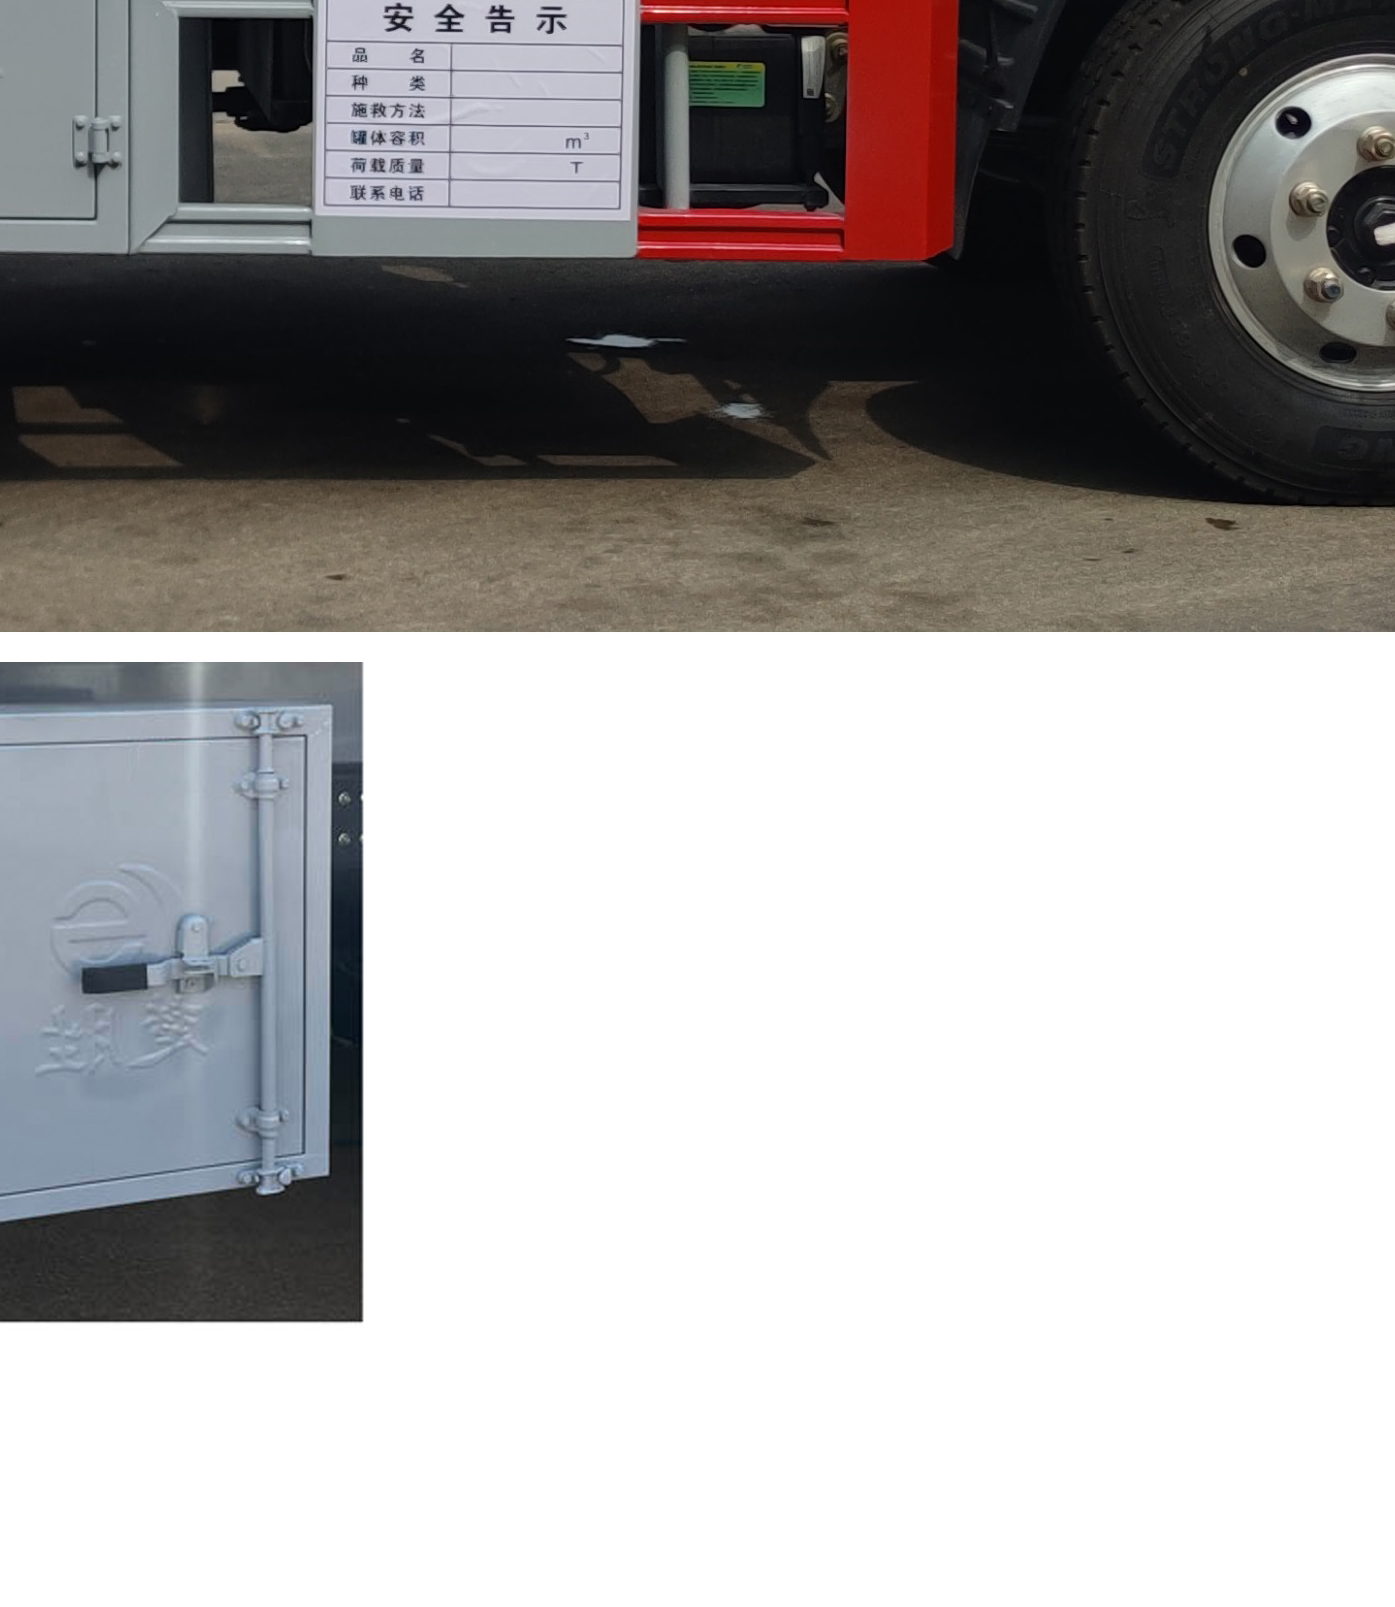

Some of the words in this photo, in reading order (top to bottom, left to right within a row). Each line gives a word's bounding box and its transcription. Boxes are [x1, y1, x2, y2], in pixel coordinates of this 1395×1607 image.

[383, 3, 567, 34] 安全告示
[351, 103, 425, 119] 施救方法
[351, 130, 425, 145] 罐体容积
[351, 158, 424, 173] 荷载质量
[571, 162, 583, 173] T
[350, 185, 424, 201] 联系电话
